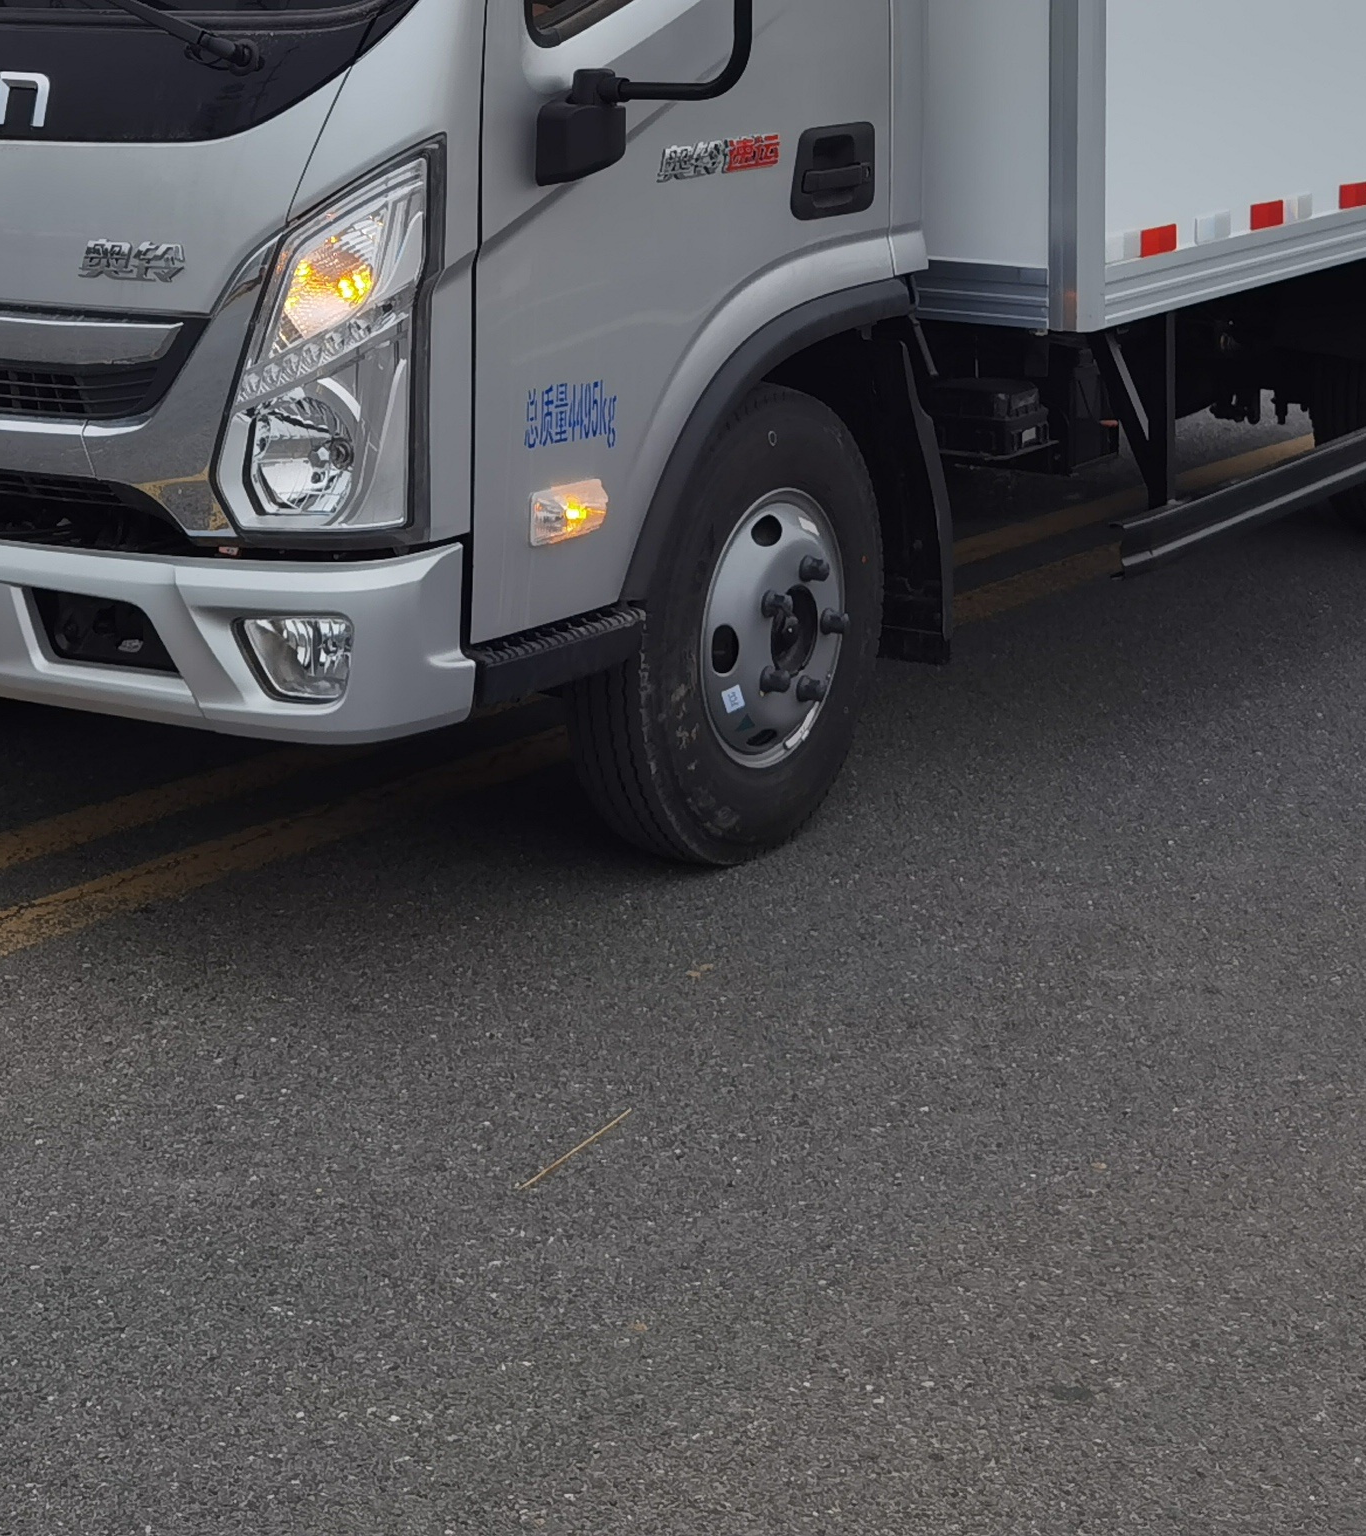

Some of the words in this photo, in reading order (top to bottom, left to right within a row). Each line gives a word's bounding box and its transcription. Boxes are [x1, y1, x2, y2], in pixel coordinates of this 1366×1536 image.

[77, 238, 186, 283] 奥铃
[523, 379, 617, 449] 总质量4495kg
